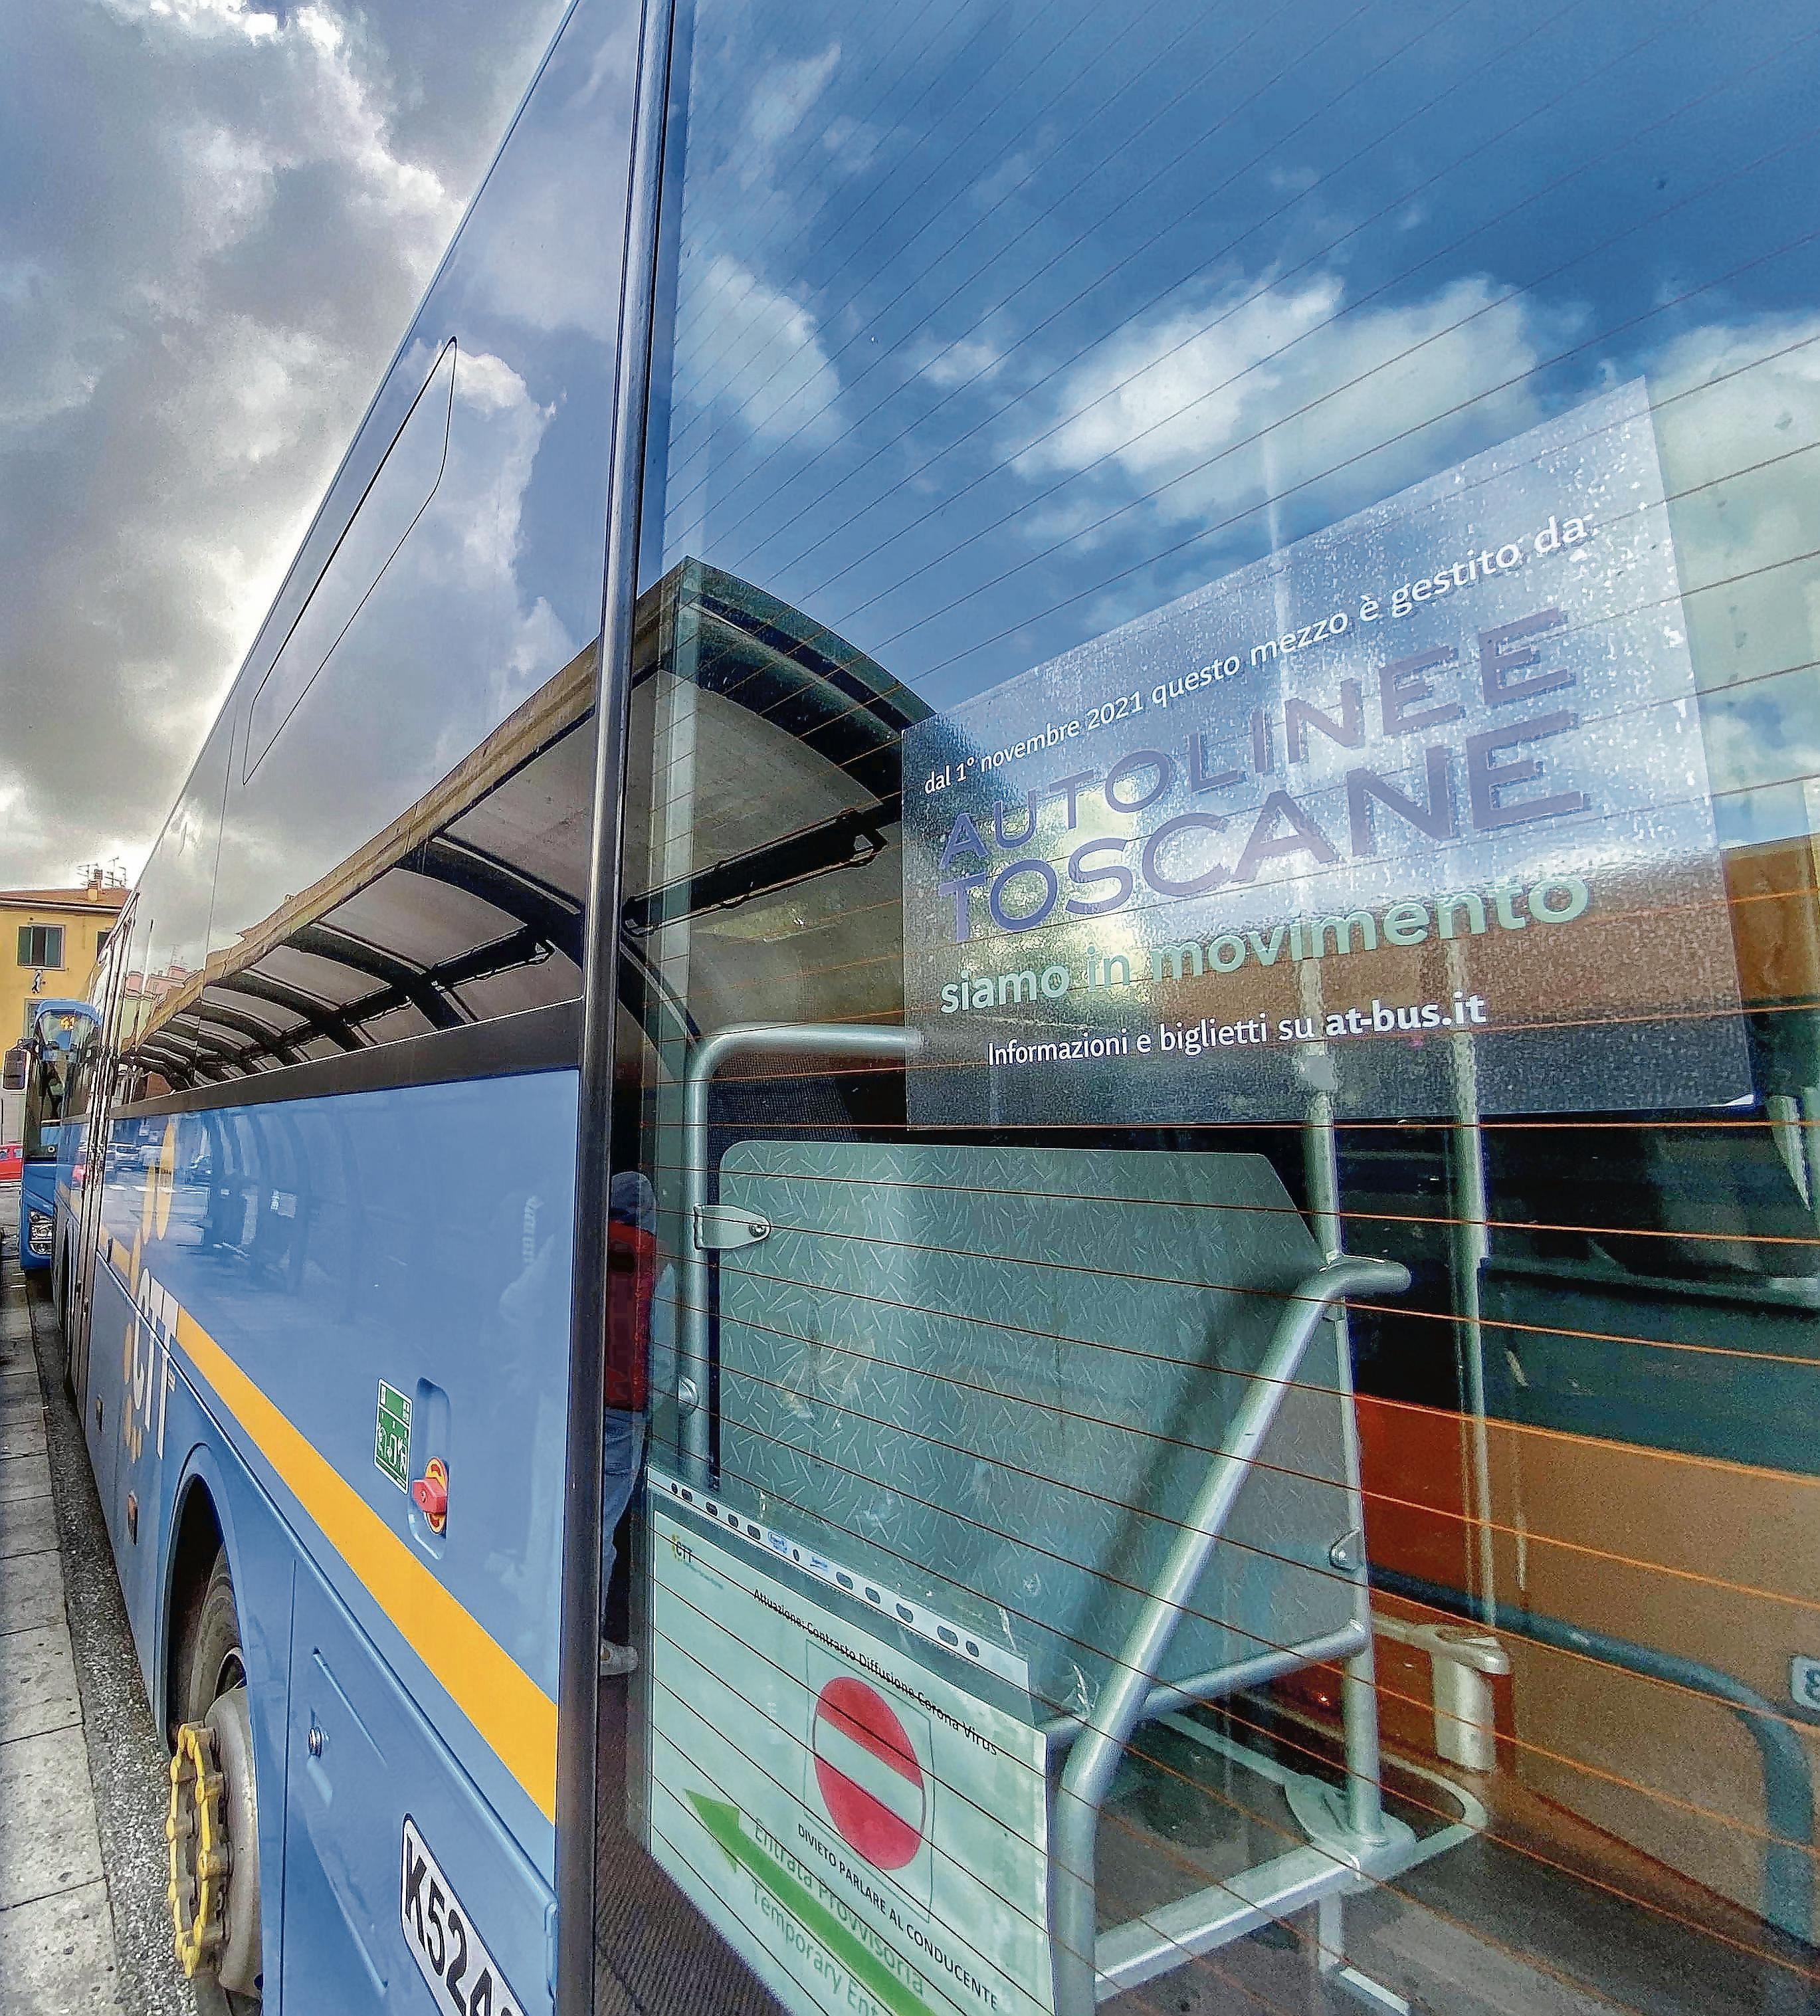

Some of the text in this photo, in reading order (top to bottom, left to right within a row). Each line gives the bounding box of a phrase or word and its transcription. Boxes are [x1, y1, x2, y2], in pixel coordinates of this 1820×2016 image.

[924, 765, 952, 795] dal
[981, 720, 1080, 772] novembre
[1086, 694, 1144, 731] 2021
[1151, 655, 1240, 708] questo
[1249, 610, 1348, 666] mezzo
[1360, 595, 1379, 623] è
[1391, 544, 1520, 618] gestito
[938, 607, 1575, 869] AUTOLINEE
[938, 710, 1585, 942] TOSCANE
[940, 874, 1589, 1015] siamo in movimento
[987, 991, 1487, 1066] Informazioni e biglietti su at-bus.it
[807, 1622, 856, 1661] Contrasto
[859, 1653, 915, 1699] Diffusione
[918, 1691, 959, 1732] Corona
[963, 1720, 997, 1756] Virus
[751, 1878, 843, 1995] Temporary
[798, 1823, 999, 2011] DIVIETO PARLARE AL CONDUCENTE
